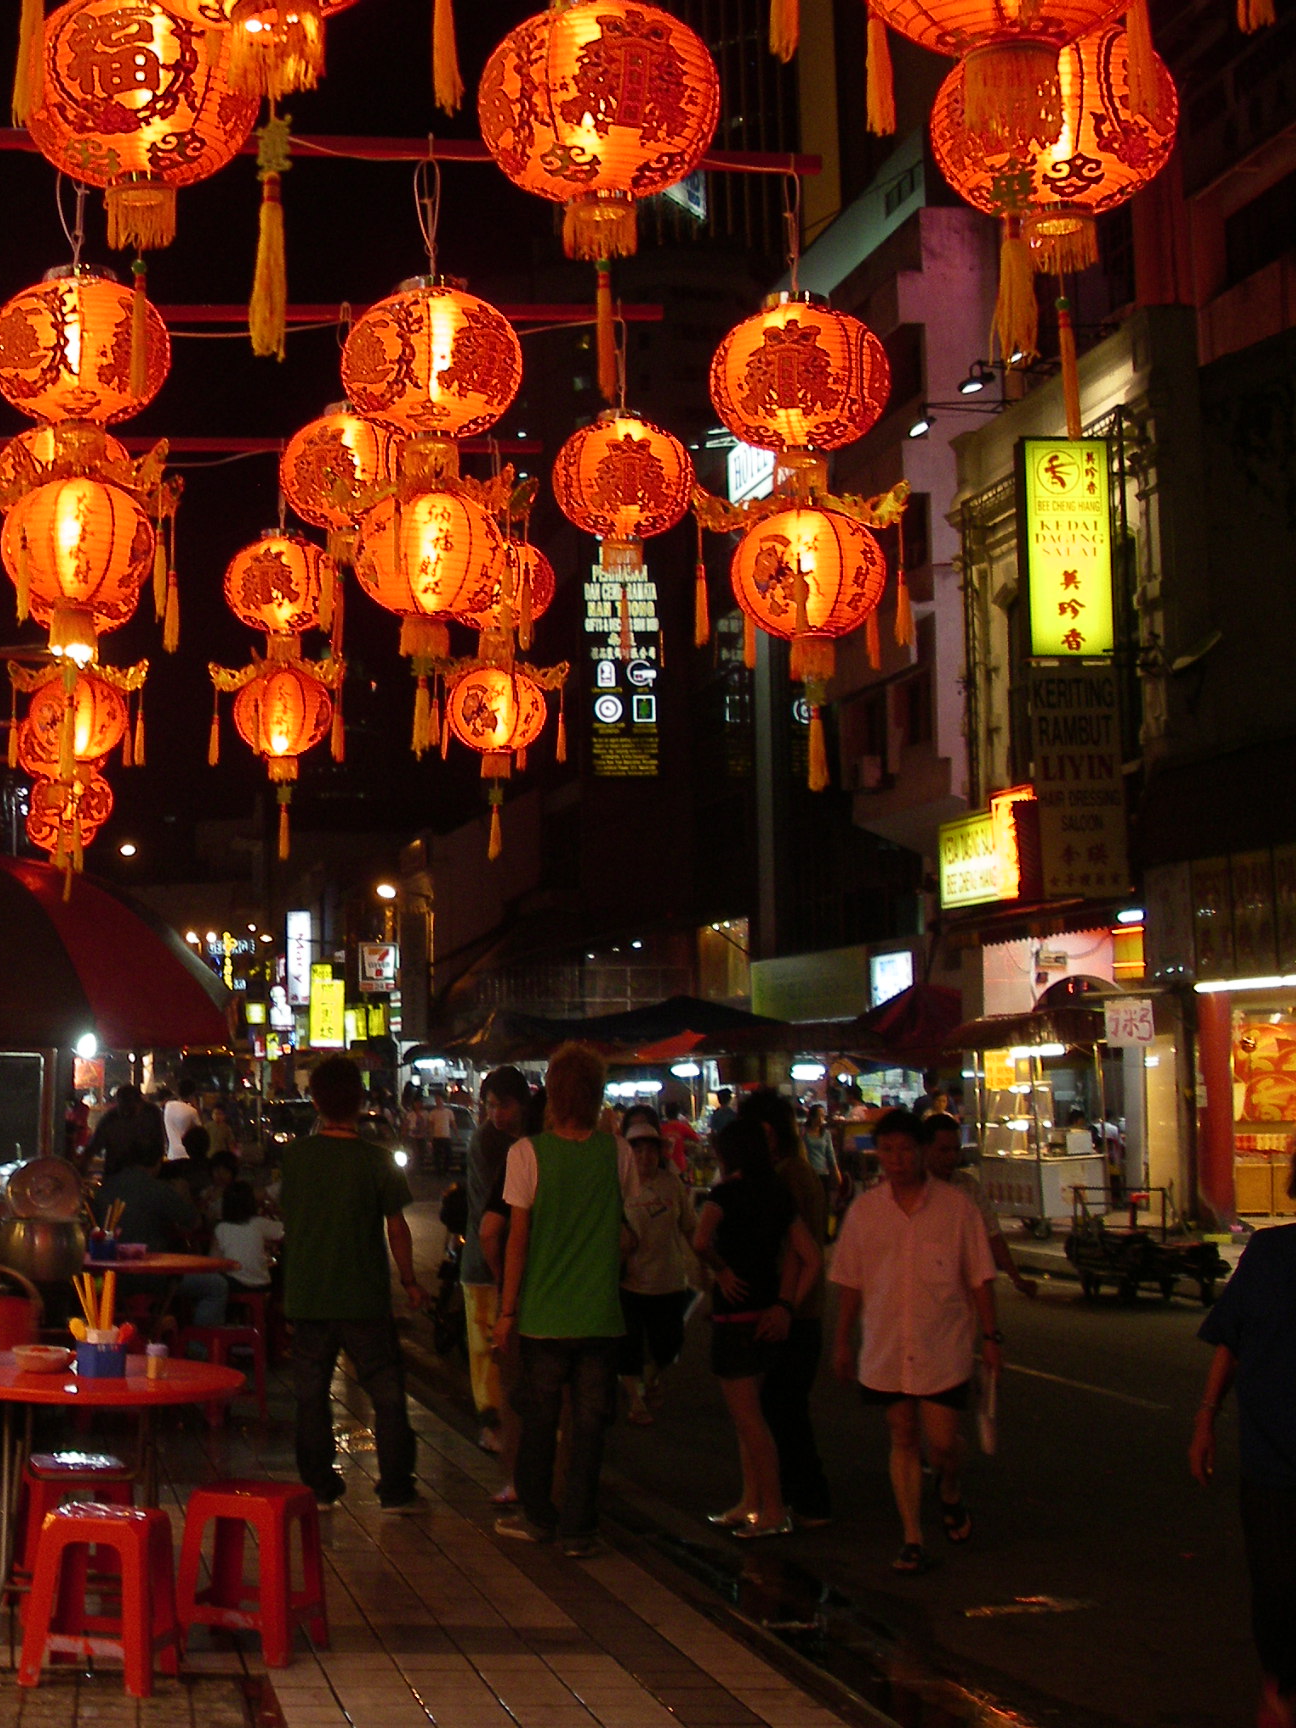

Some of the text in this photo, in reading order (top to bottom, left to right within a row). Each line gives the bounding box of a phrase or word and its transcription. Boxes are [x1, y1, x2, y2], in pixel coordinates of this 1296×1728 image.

[1037, 500, 1101, 512] BEE CHENG HIANG
[1039, 520, 1099, 532] KEDAI
[1034, 533, 1105, 544] DAGING
[1033, 677, 1115, 709] KERITING
[1038, 714, 1113, 746] RAMBUT
[1041, 754, 1114, 782] LIYIN
